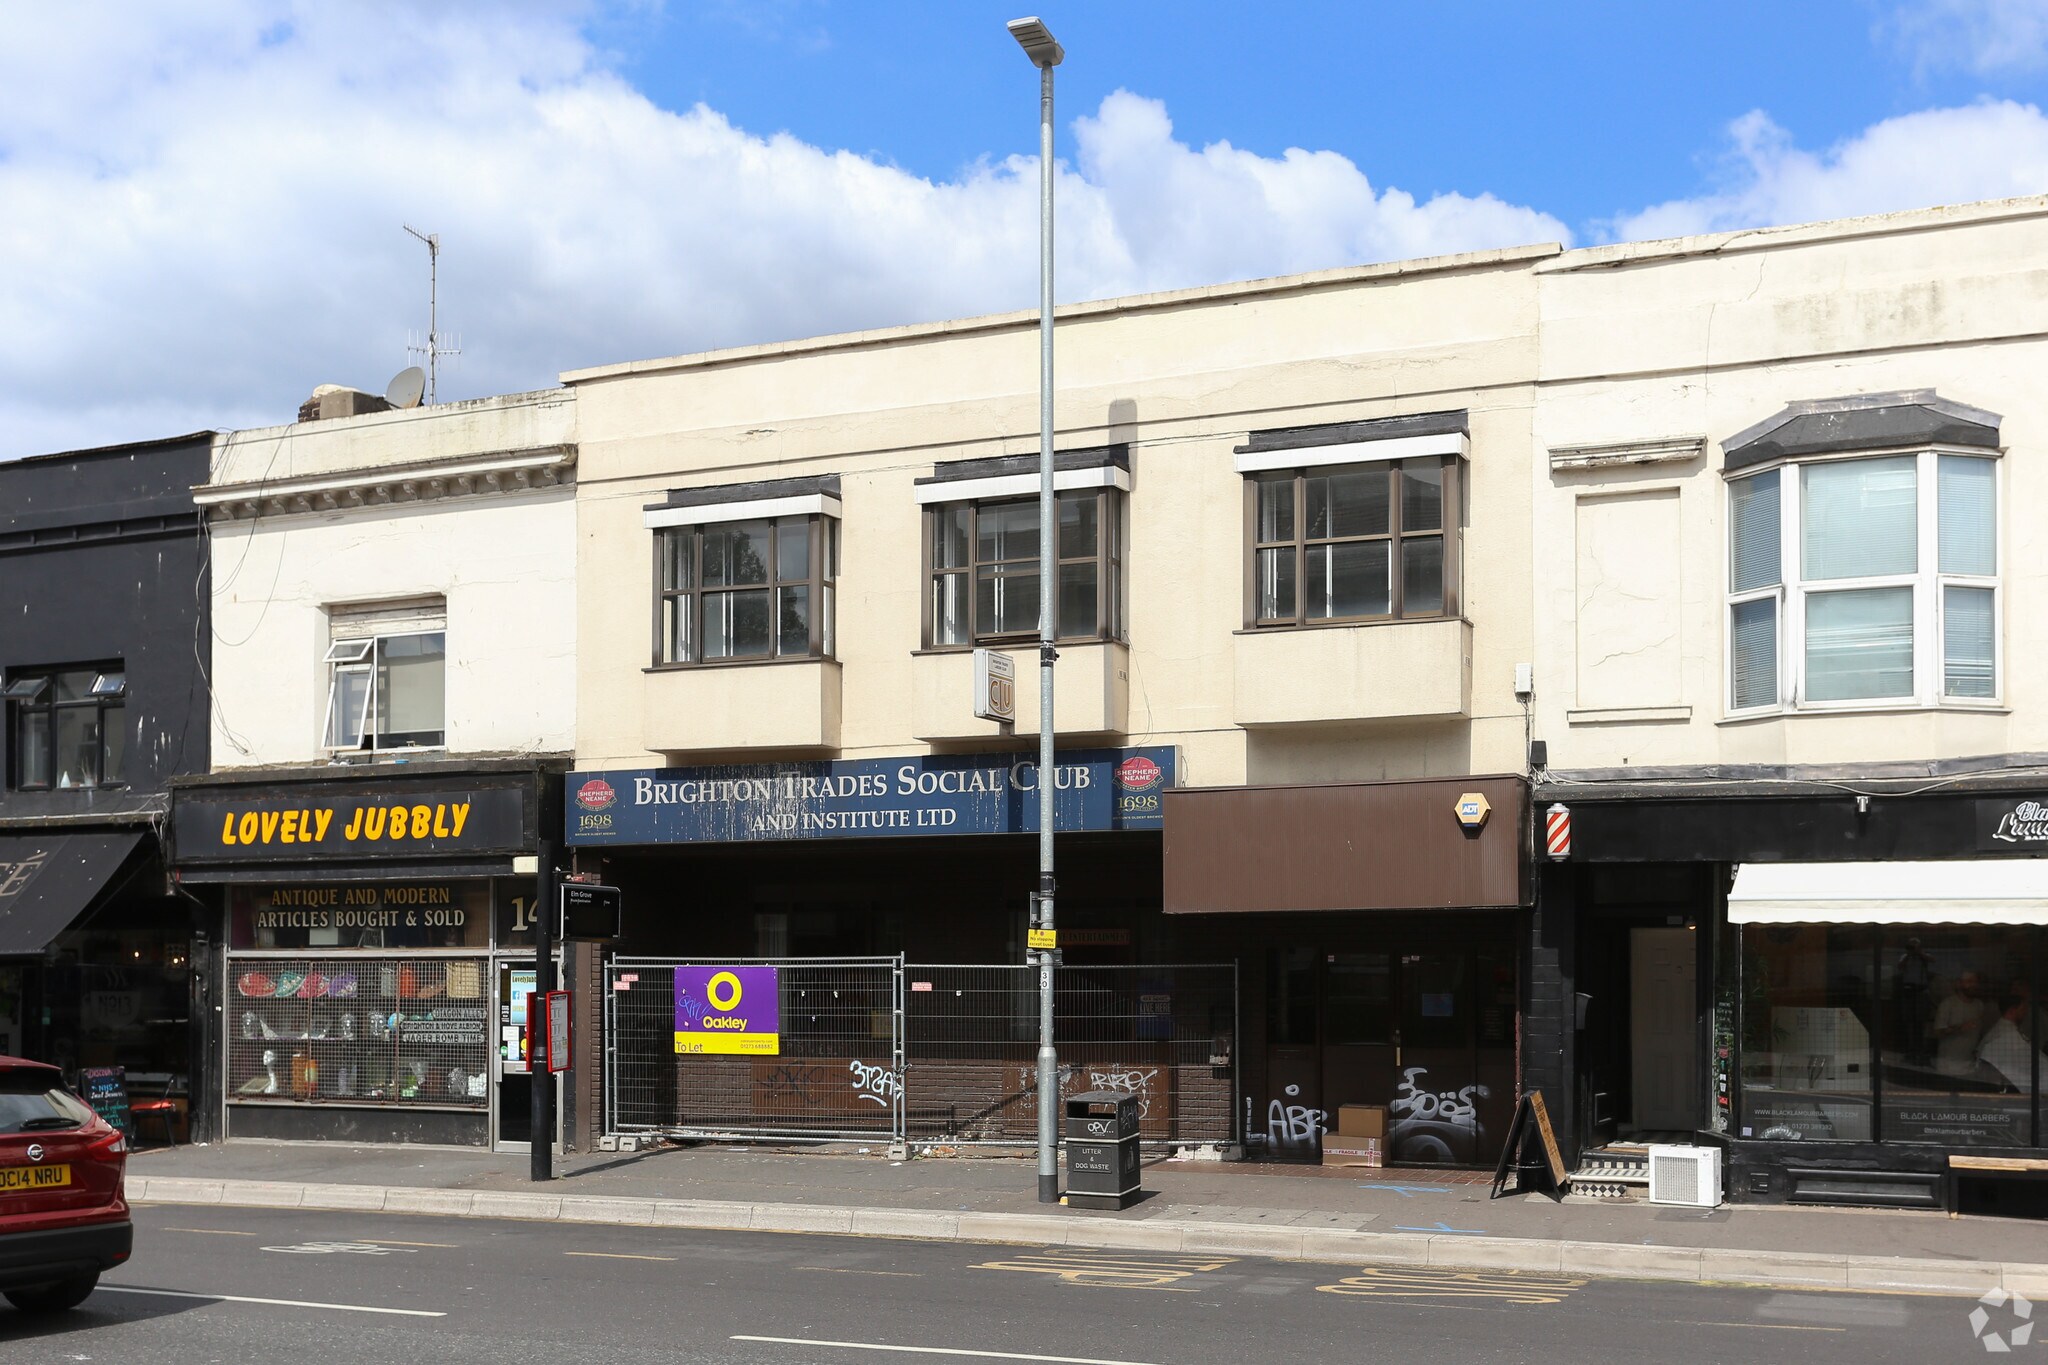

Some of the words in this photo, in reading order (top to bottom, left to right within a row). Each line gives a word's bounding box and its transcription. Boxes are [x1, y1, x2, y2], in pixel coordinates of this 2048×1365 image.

[634, 777, 772, 805] BRIGHTON
[779, 771, 888, 800] TRADES
[897, 765, 1003, 796] SOCIAL
[1117, 795, 1158, 812] 1698
[1462, 804, 1478, 813] ADT
[222, 808, 334, 845] LOVELY
[344, 803, 471, 841] JUBBLY
[579, 814, 612, 829] 1698
[750, 813, 797, 832] AND
[802, 809, 910, 830] INSTITUTE
[917, 808, 957, 827] LTD
[271, 889, 338, 907] ANTIQUE
[345, 888, 377, 905] AND
[383, 887, 450, 904] MODERN
[258, 911, 328, 928] ARTICLES
[335, 910, 399, 927] BOUGHT
[406, 910, 418, 926] &
[424, 910, 465, 926] SOLD
[703, 1016, 747, 1032] Oakley
[676, 1041, 687, 1052] To
[688, 1042, 703, 1052] Let
[1900, 1112, 1928, 1120] BLACK
[1970, 1113, 2010, 1122] BARBERS
[35, 1167, 62, 1185] NRU
